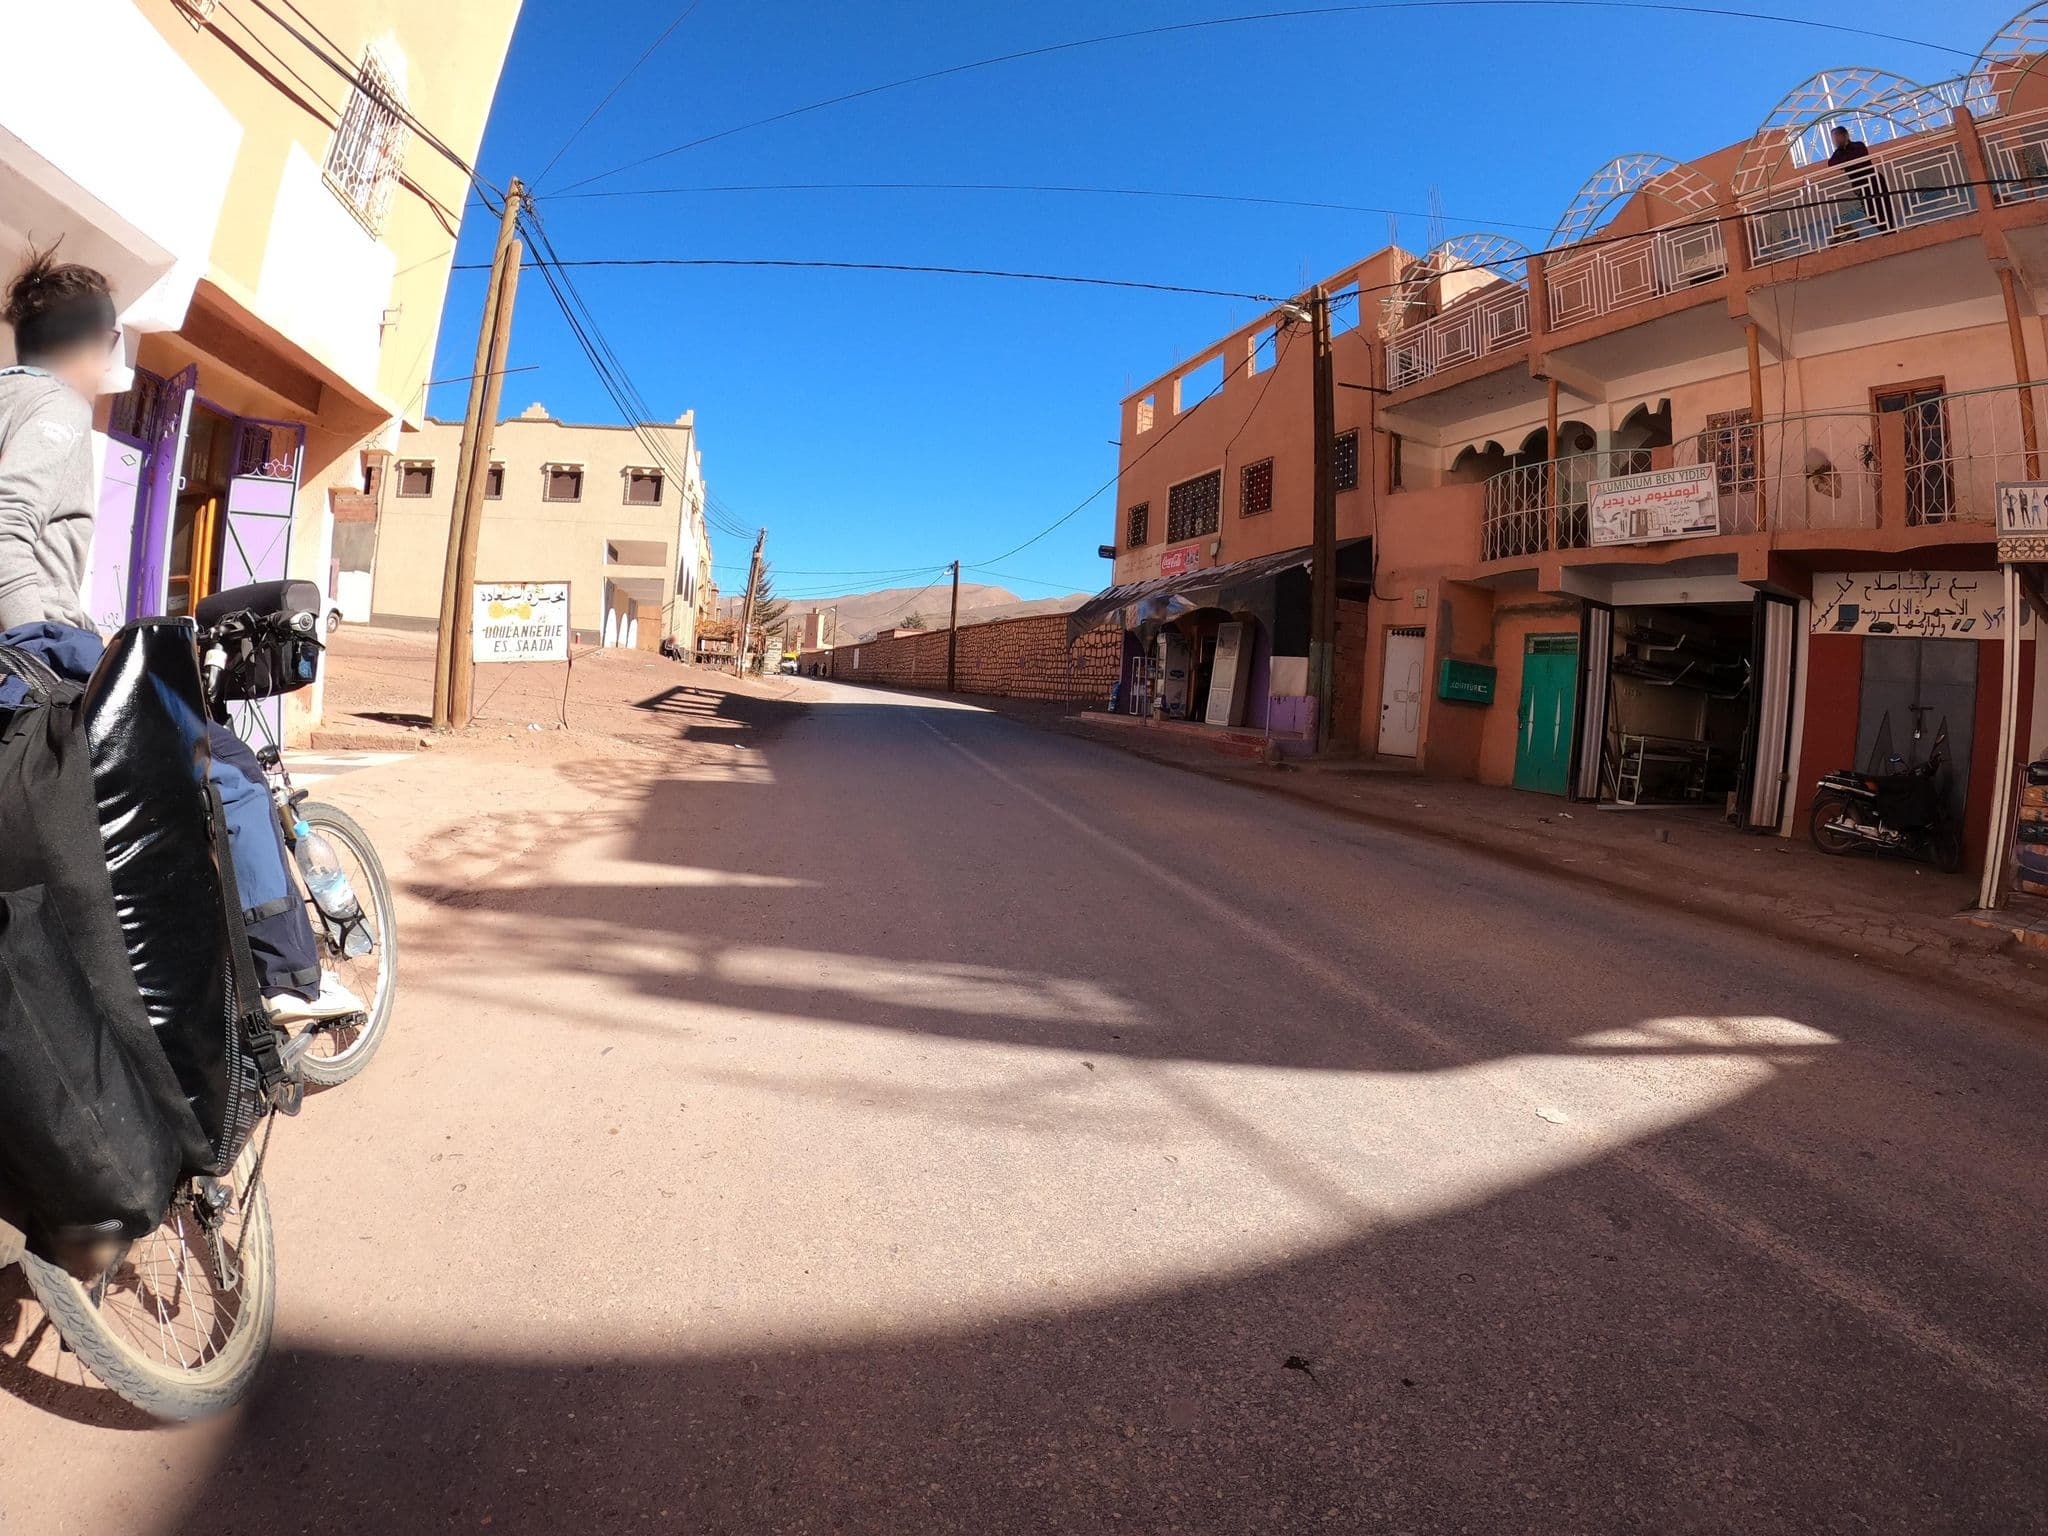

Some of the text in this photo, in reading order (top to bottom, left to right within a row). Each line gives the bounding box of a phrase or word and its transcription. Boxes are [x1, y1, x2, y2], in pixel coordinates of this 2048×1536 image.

[1597, 468, 1706, 493] ALUMINIUM BEN YIDIR
[1628, 494, 1641, 506] بن
[1949, 577, 1978, 600] بيع
